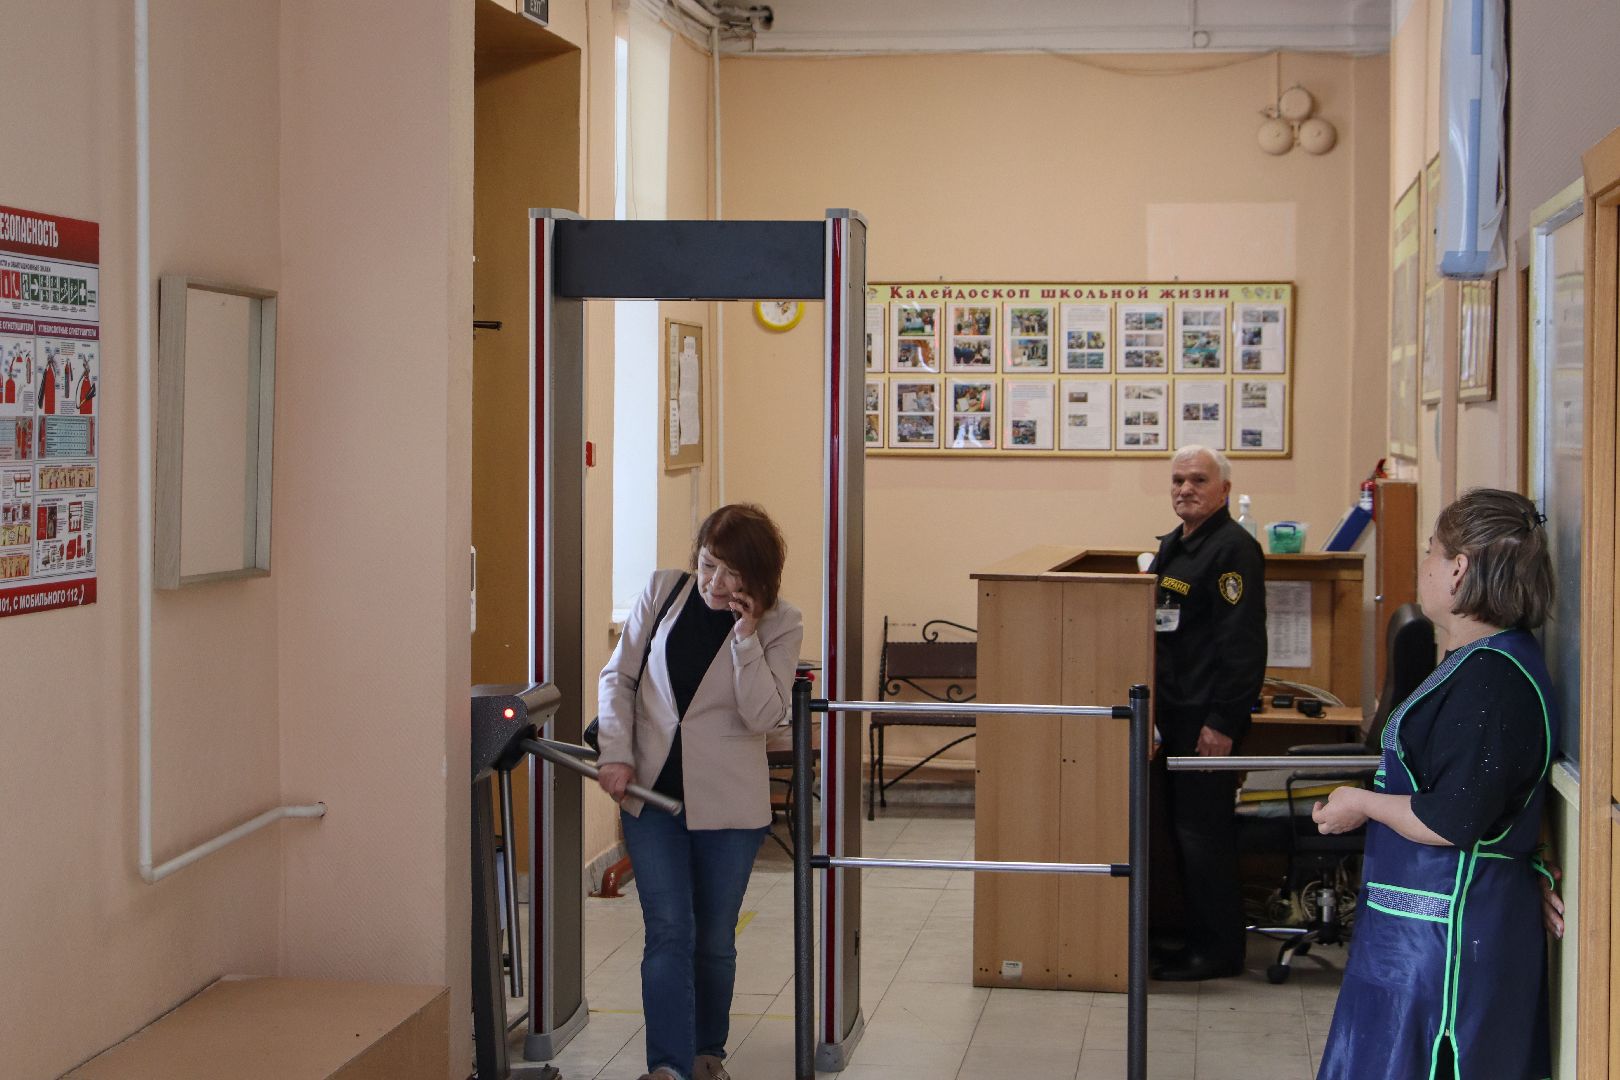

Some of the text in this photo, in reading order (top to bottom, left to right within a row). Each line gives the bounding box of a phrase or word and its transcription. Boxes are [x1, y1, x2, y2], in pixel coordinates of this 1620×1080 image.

[890, 286, 1229, 299] Калейдоскоп школьной жизни
[13, 595, 19, 610] С
[20, 589, 66, 609] МОБИЛЬНОГО
[66, 587, 78, 602] 112
